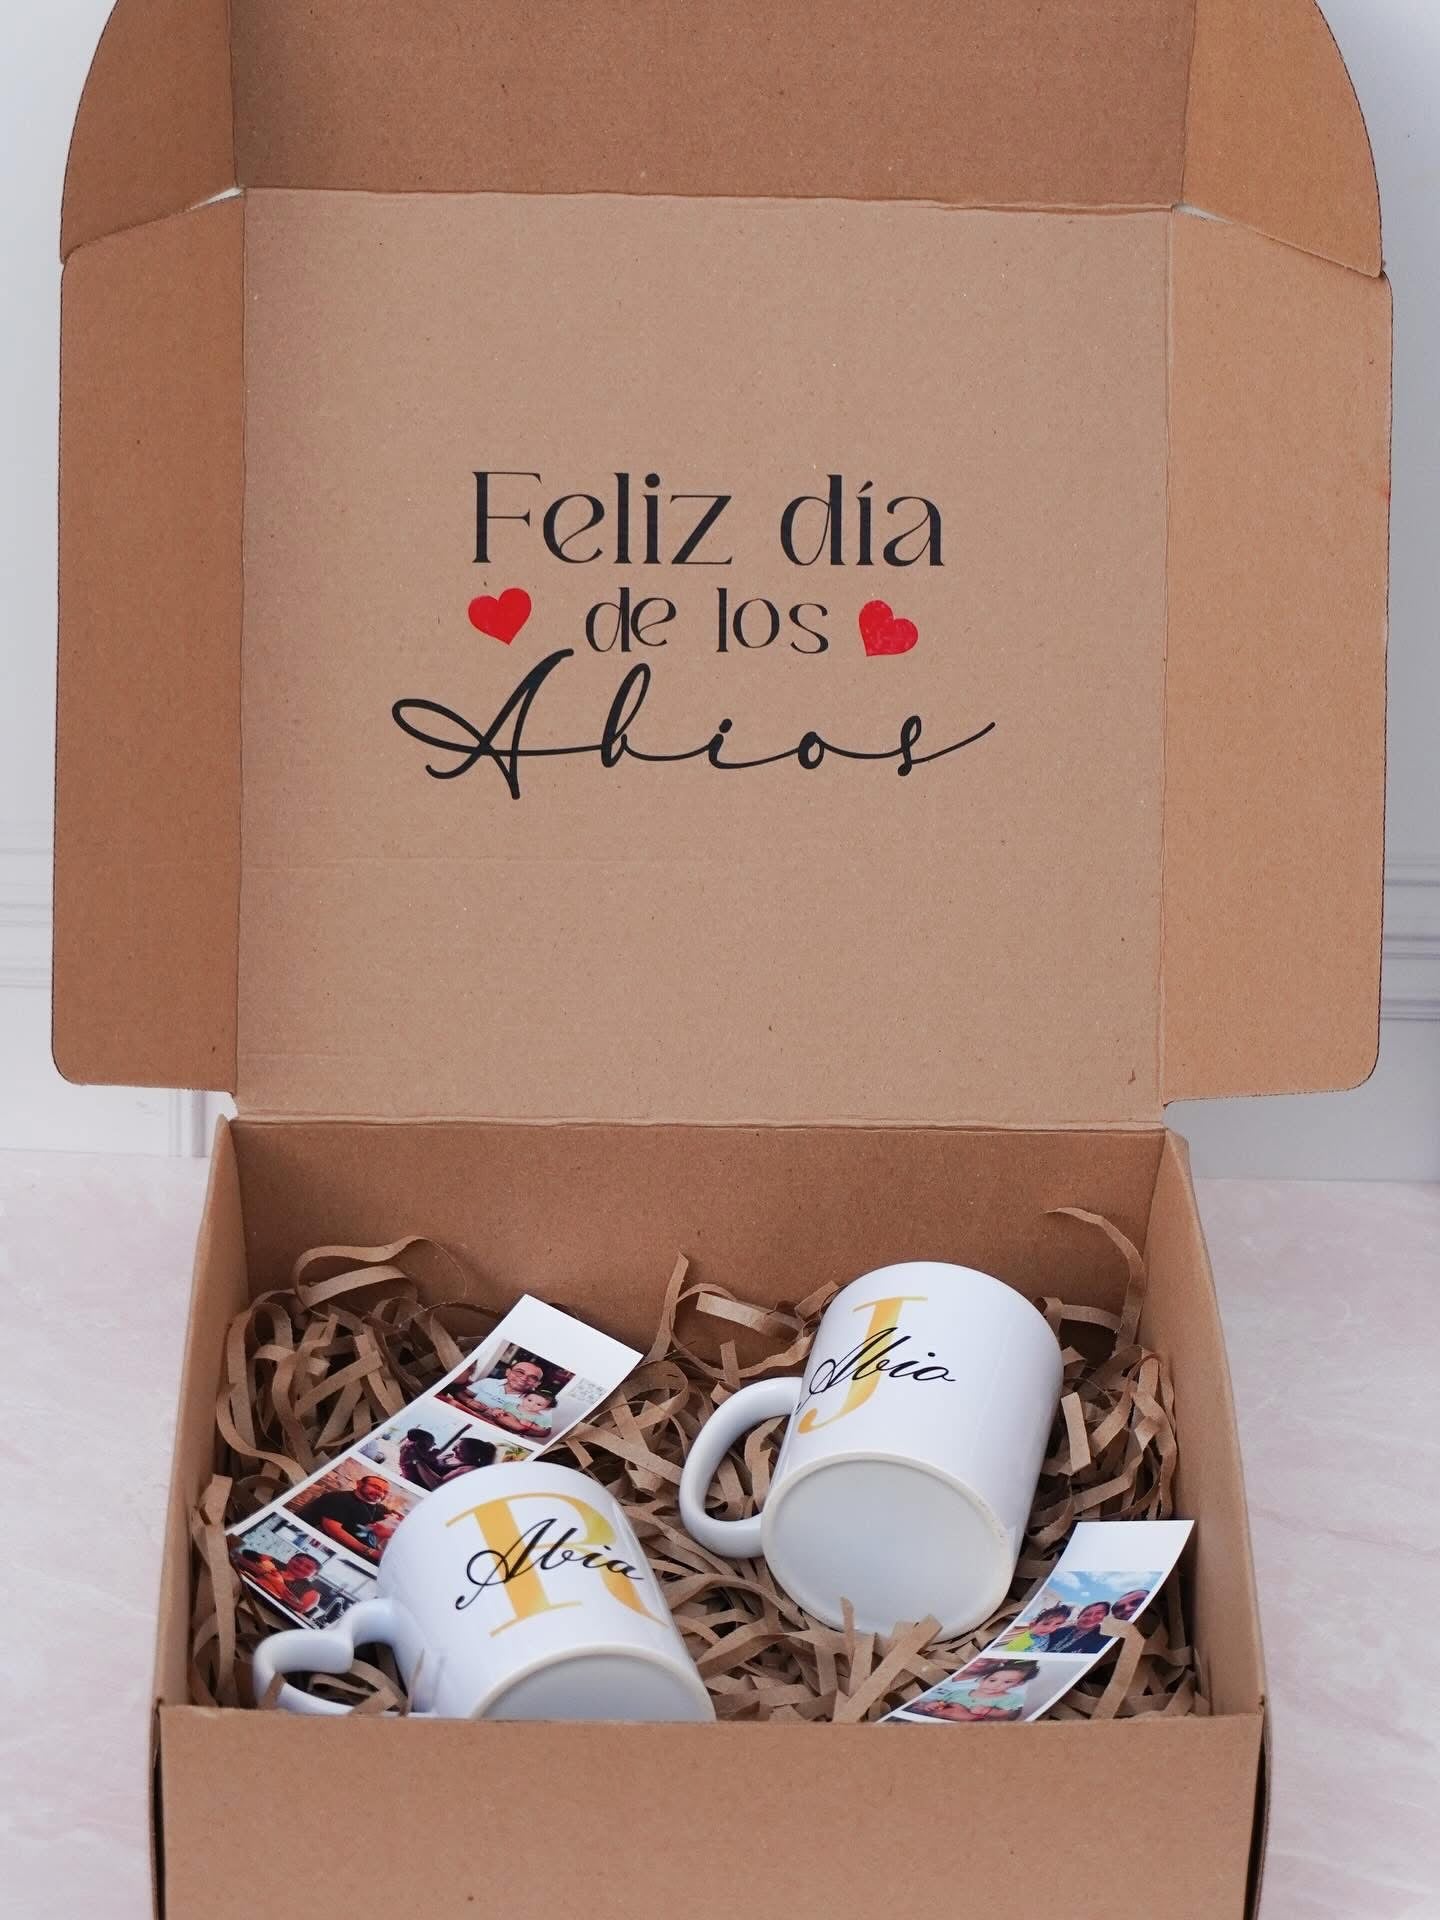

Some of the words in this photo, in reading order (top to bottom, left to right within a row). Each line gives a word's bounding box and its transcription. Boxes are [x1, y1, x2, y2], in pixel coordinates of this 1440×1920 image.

[472, 471, 733, 565] Feliz
[780, 474, 945, 567] día
[585, 586, 677, 653] de
[716, 587, 829, 654] los
[391, 648, 996, 800] Abios
[797, 1296, 928, 1435] J
[445, 1492, 670, 1637] R
